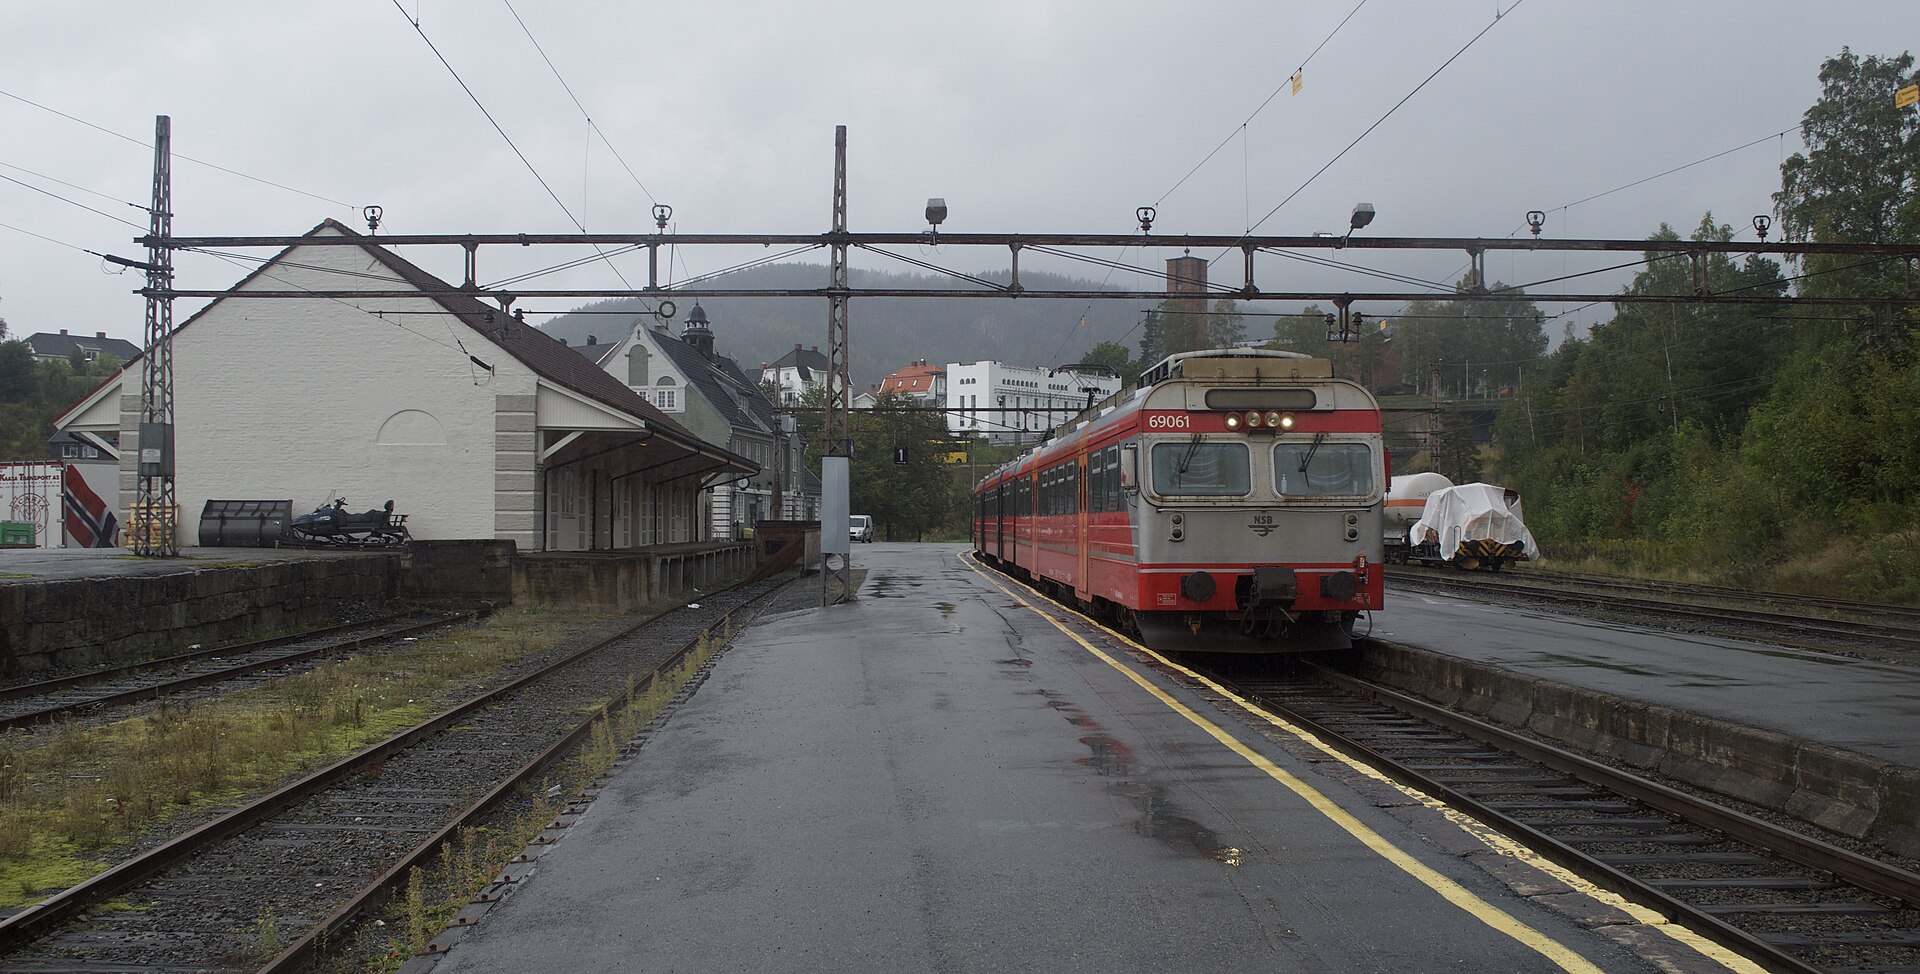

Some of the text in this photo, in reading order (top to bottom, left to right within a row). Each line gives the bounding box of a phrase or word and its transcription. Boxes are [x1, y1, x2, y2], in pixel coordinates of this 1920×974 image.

[1149, 415, 1190, 428] 69061
[898, 448, 903, 461] 1
[1254, 515, 1273, 524] NSB
